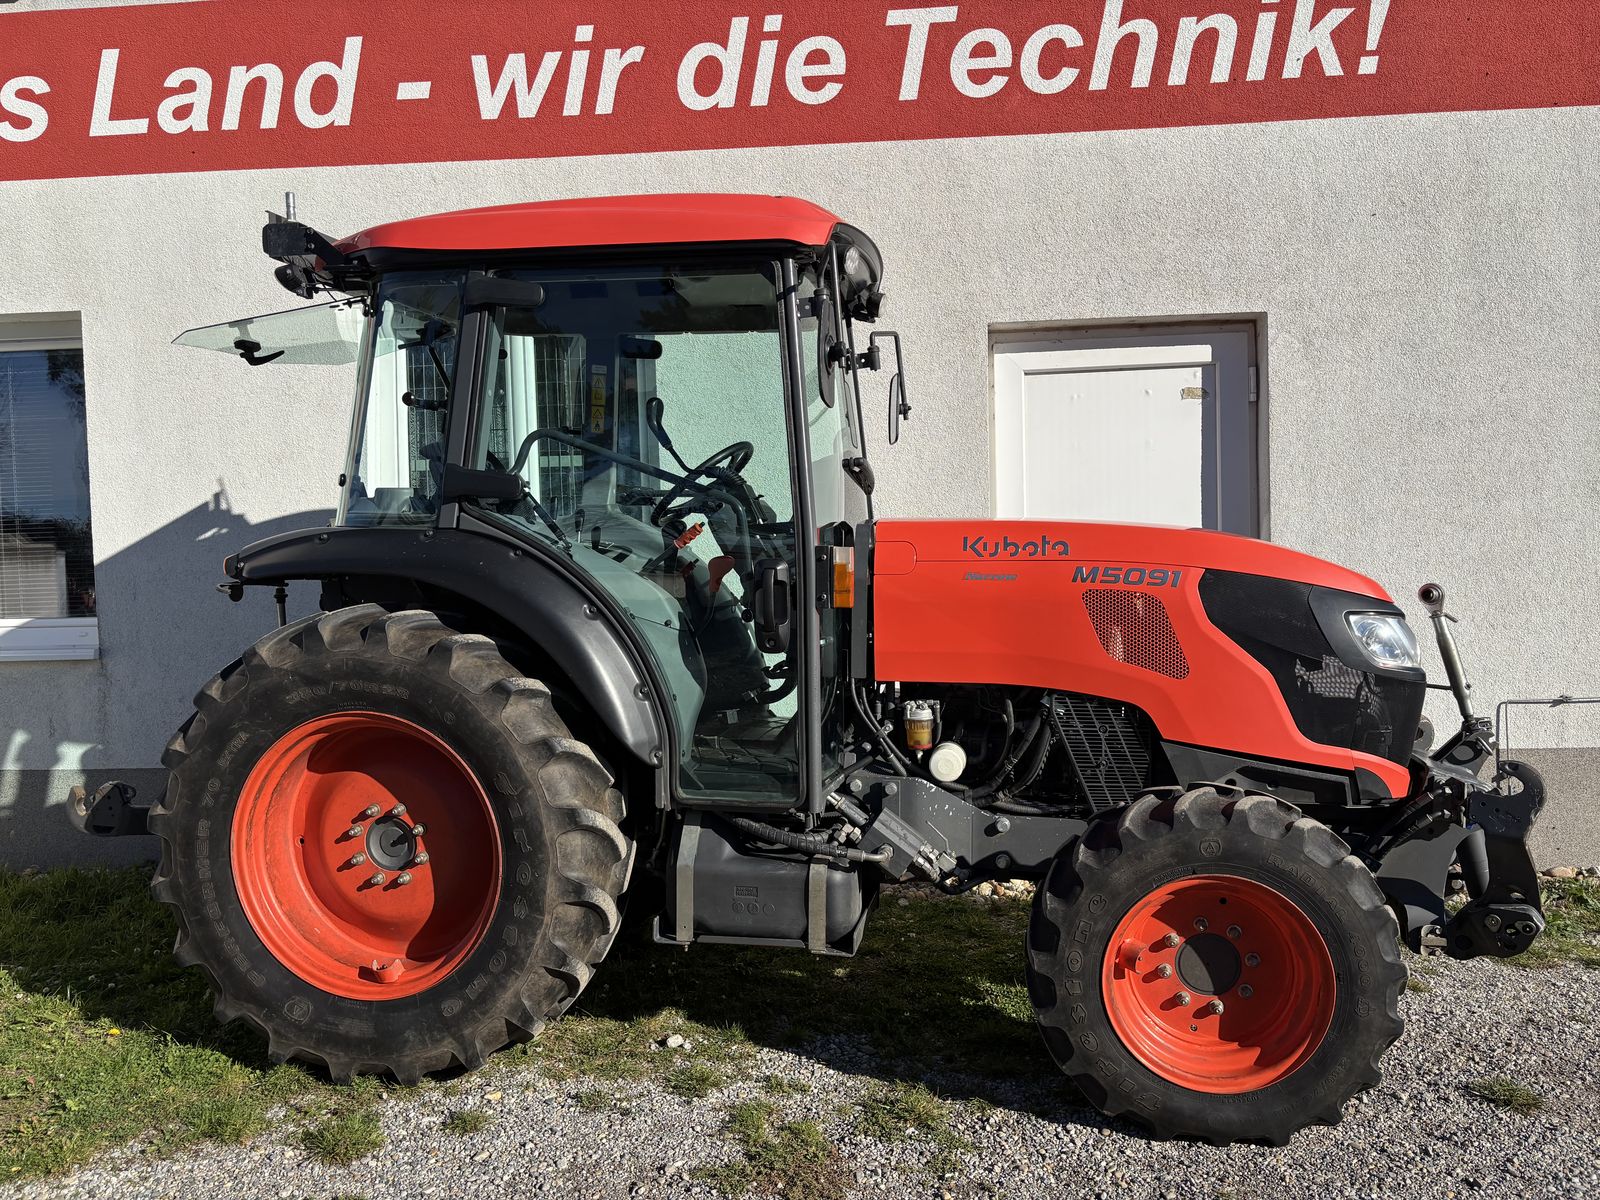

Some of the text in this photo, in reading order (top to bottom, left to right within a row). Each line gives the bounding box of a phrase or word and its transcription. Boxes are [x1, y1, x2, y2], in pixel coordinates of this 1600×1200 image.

[89, 36, 363, 137] Land
[396, 81, 432, 100] -
[470, 25, 645, 120] wir
[676, 14, 847, 111] die
[885, 0, 1391, 101] Technik!
[962, 535, 1070, 558] Kubota
[1071, 565, 1182, 588] M5091
